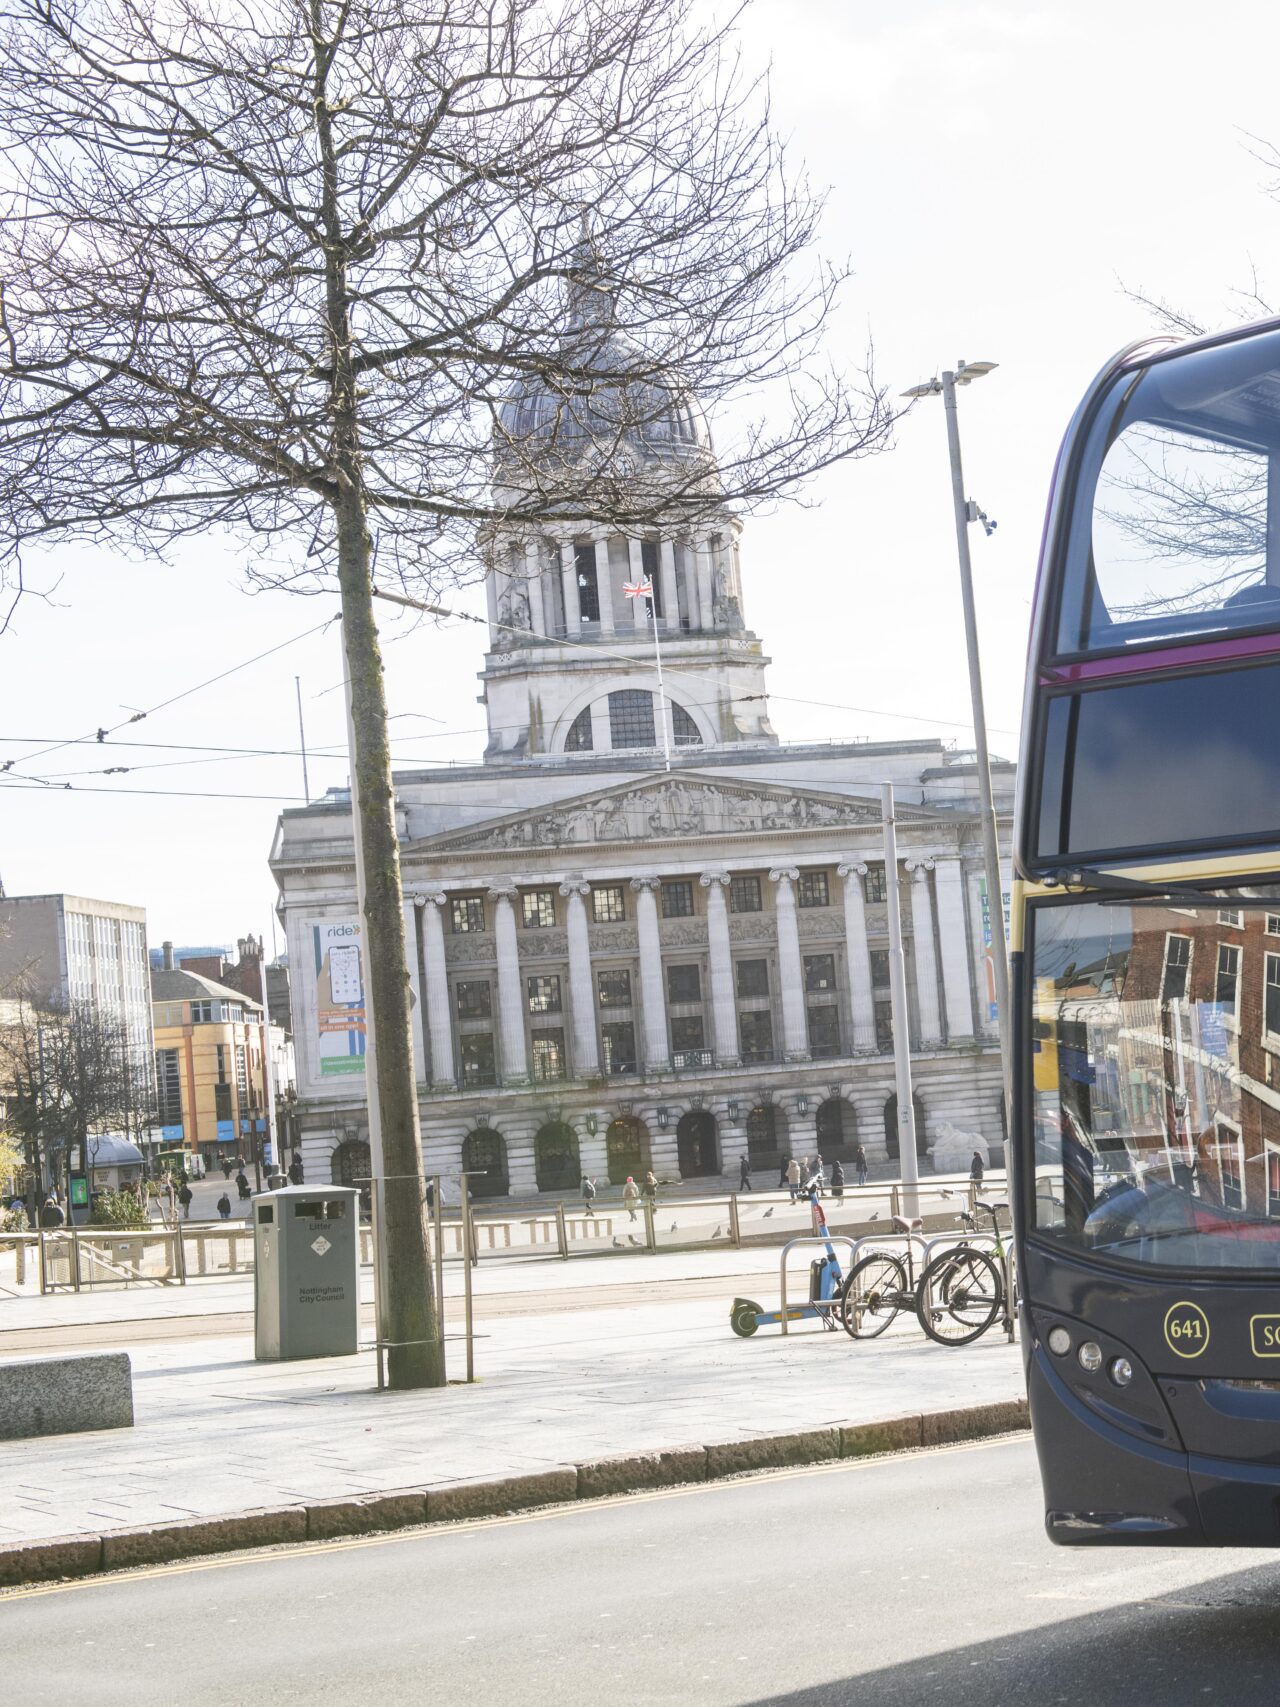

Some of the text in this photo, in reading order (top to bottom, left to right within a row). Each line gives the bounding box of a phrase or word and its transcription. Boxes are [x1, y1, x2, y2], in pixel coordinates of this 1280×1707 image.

[327, 926, 353, 937] ride
[309, 1223, 331, 1231] Litter
[299, 1286, 344, 1296] Nottingham
[299, 1294, 344, 1304] City Council
[1170, 1319, 1203, 1339] 641
